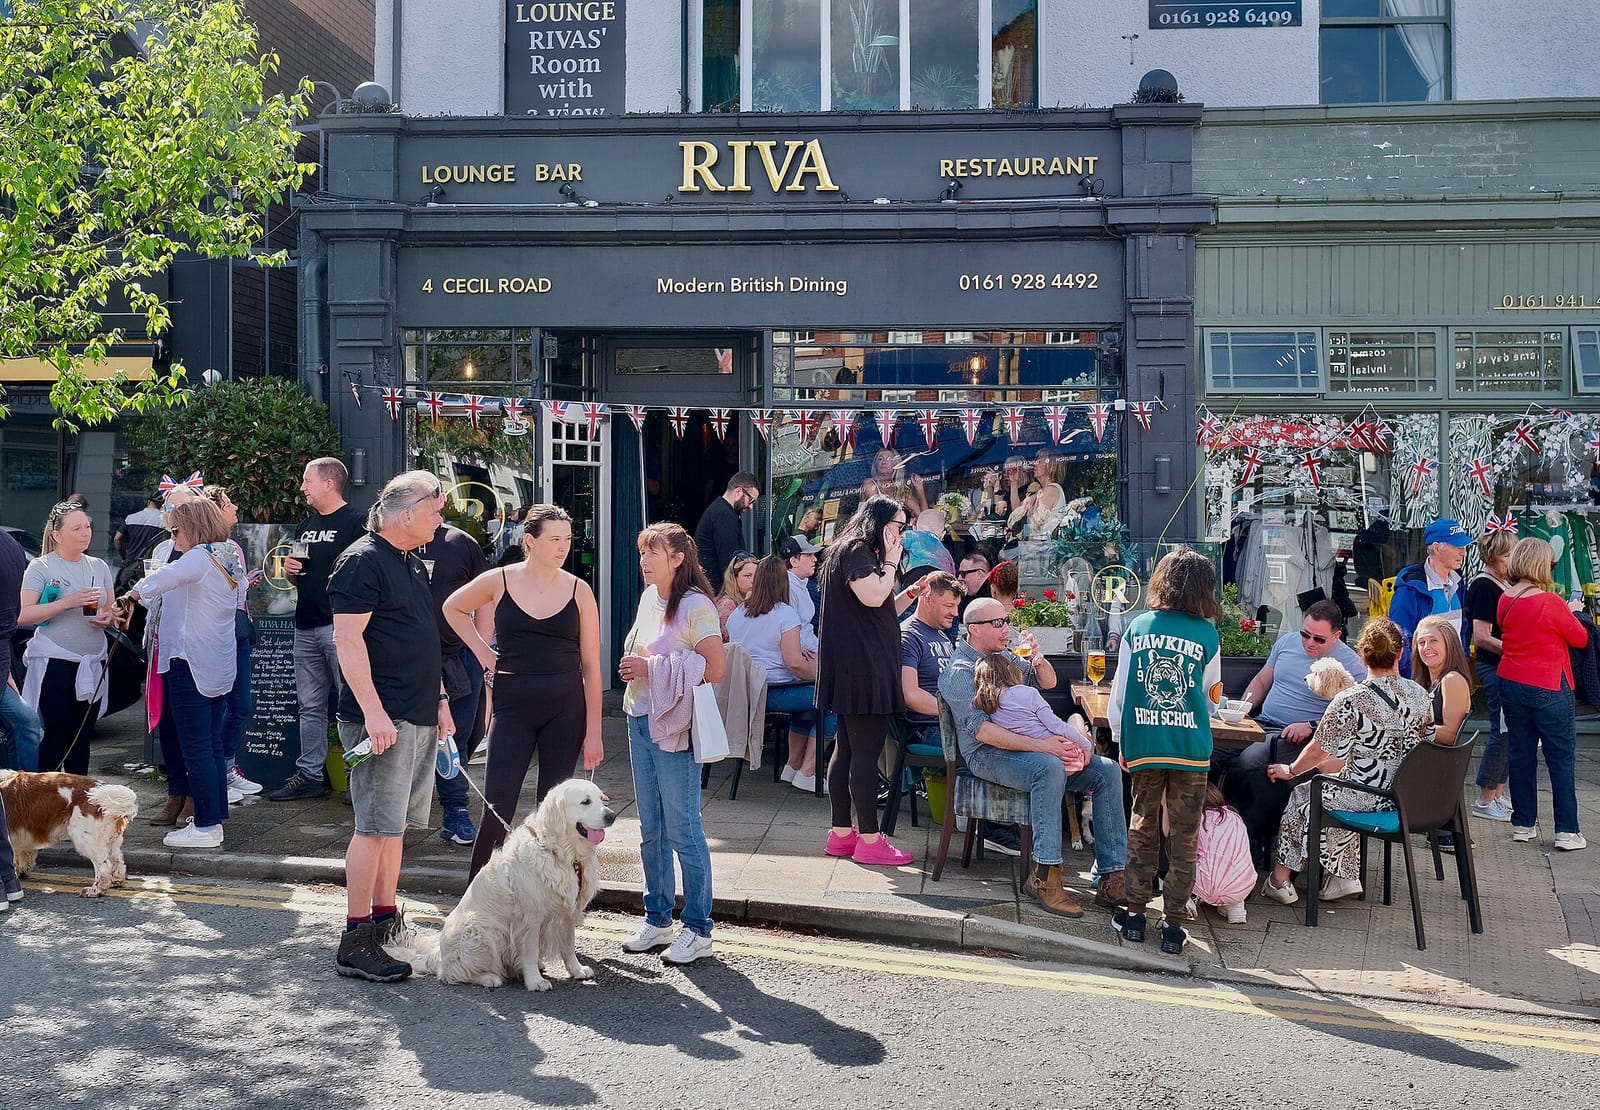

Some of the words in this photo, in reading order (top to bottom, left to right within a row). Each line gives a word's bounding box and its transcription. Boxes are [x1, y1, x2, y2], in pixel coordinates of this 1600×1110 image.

[516, 2, 616, 23] LOUNGE
[1159, 10, 1201, 24] 0161
[1205, 8, 1240, 26] 928
[1245, 8, 1292, 25] 6409
[528, 27, 608, 50] RIVAS'
[530, 55, 602, 74] Room
[538, 78, 593, 99] with
[421, 164, 516, 184] LOUNGE
[535, 162, 583, 183] BAR
[677, 138, 840, 193] RIVA
[939, 155, 1099, 177] RESTAURANT
[422, 278, 434, 293] 4
[443, 278, 495, 294] CECIL
[498, 277, 552, 293] ROAD
[656, 277, 725, 293] Modern
[730, 276, 784, 293] British
[789, 276, 848, 297] Dining
[958, 274, 1003, 290] 0161
[1011, 273, 1046, 290] 928
[1051, 272, 1099, 289] 4492
[1502, 294, 1545, 308] 0161
[1555, 294, 1585, 308] 941
[301, 530, 338, 544] CELINE
[1101, 575, 1130, 604] R
[258, 619, 278, 629] RIVA
[1132, 633, 1205, 662] HAWKINS
[1134, 706, 1160, 726] HIGH
